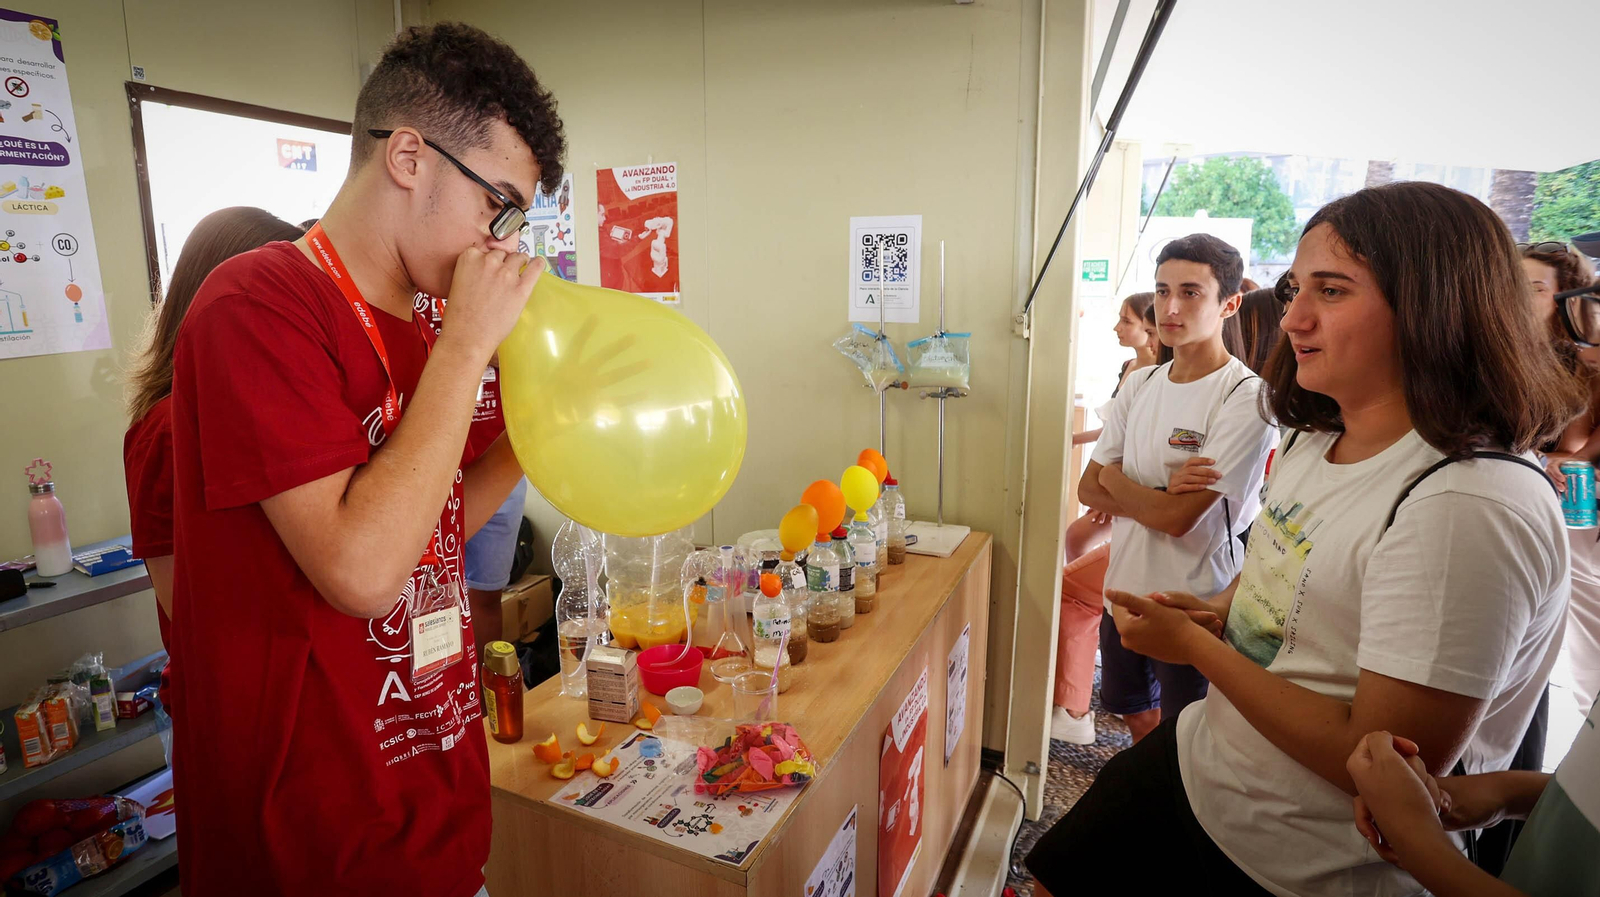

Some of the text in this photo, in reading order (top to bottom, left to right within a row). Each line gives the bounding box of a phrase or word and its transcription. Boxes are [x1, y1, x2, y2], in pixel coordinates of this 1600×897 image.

[17, 58, 56, 69] desarrollar
[38, 143, 51, 151] LA
[622, 165, 675, 178] AVANZANDO
[651, 175, 669, 183] DUAL
[631, 183, 665, 192] INDUSTRIA
[12, 203, 49, 212] LÁCTICA
[354, 301, 373, 328] edebé
[0, 334, 31, 342] stilación
[1301, 568, 1312, 587] SAND
[1295, 600, 1303, 615] SUN
[415, 709, 437, 720] FECYT
[383, 733, 405, 748] CSIC
